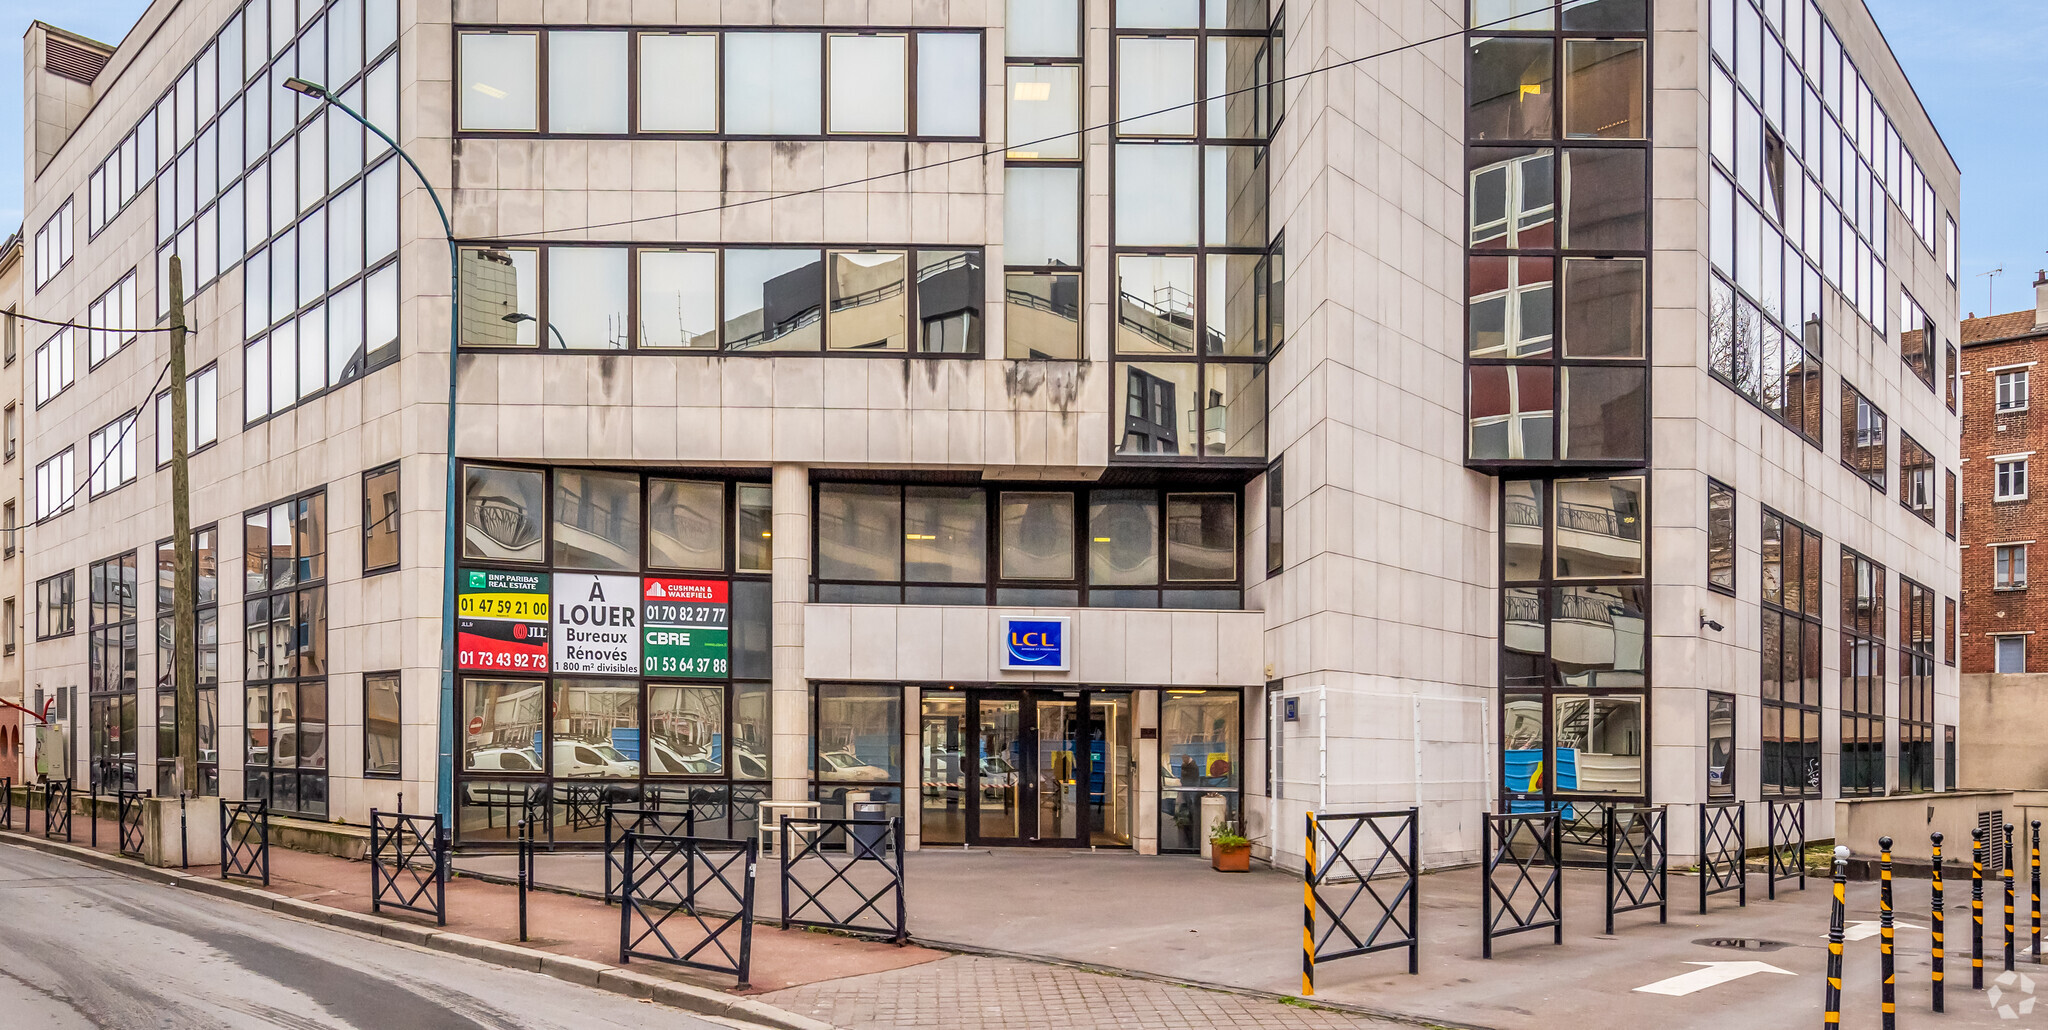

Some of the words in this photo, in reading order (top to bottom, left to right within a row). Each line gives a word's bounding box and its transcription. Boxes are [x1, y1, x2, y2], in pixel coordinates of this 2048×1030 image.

[507, 575, 538, 583] PARIBAS
[588, 575, 605, 602] À
[461, 598, 473, 611] 01
[479, 599, 493, 612] 47
[498, 600, 511, 613] 59
[516, 601, 527, 614] 21
[533, 603, 547, 615] 00
[647, 605, 658, 620] 01
[662, 606, 676, 620] 70
[680, 607, 693, 621] 82
[696, 607, 709, 621] 27
[713, 608, 726, 622] 77
[559, 604, 635, 627] LOUER
[528, 627, 547, 638] JLL
[566, 628, 627, 643] Bureaux
[646, 632, 690, 646] CBRE
[1012, 632, 1054, 646] LCL
[460, 651, 473, 664] 01
[478, 652, 493, 665] 73
[496, 653, 511, 666] 43
[514, 653, 528, 667] 92
[532, 654, 546, 668] 73
[566, 646, 627, 660] Rénovés
[563, 662, 579, 670] 800
[597, 663, 637, 673] divisibles
[646, 657, 657, 671] 01
[662, 657, 676, 671] 53
[679, 658, 694, 672] 64
[697, 658, 710, 672] 37
[713, 659, 726, 673] 88
